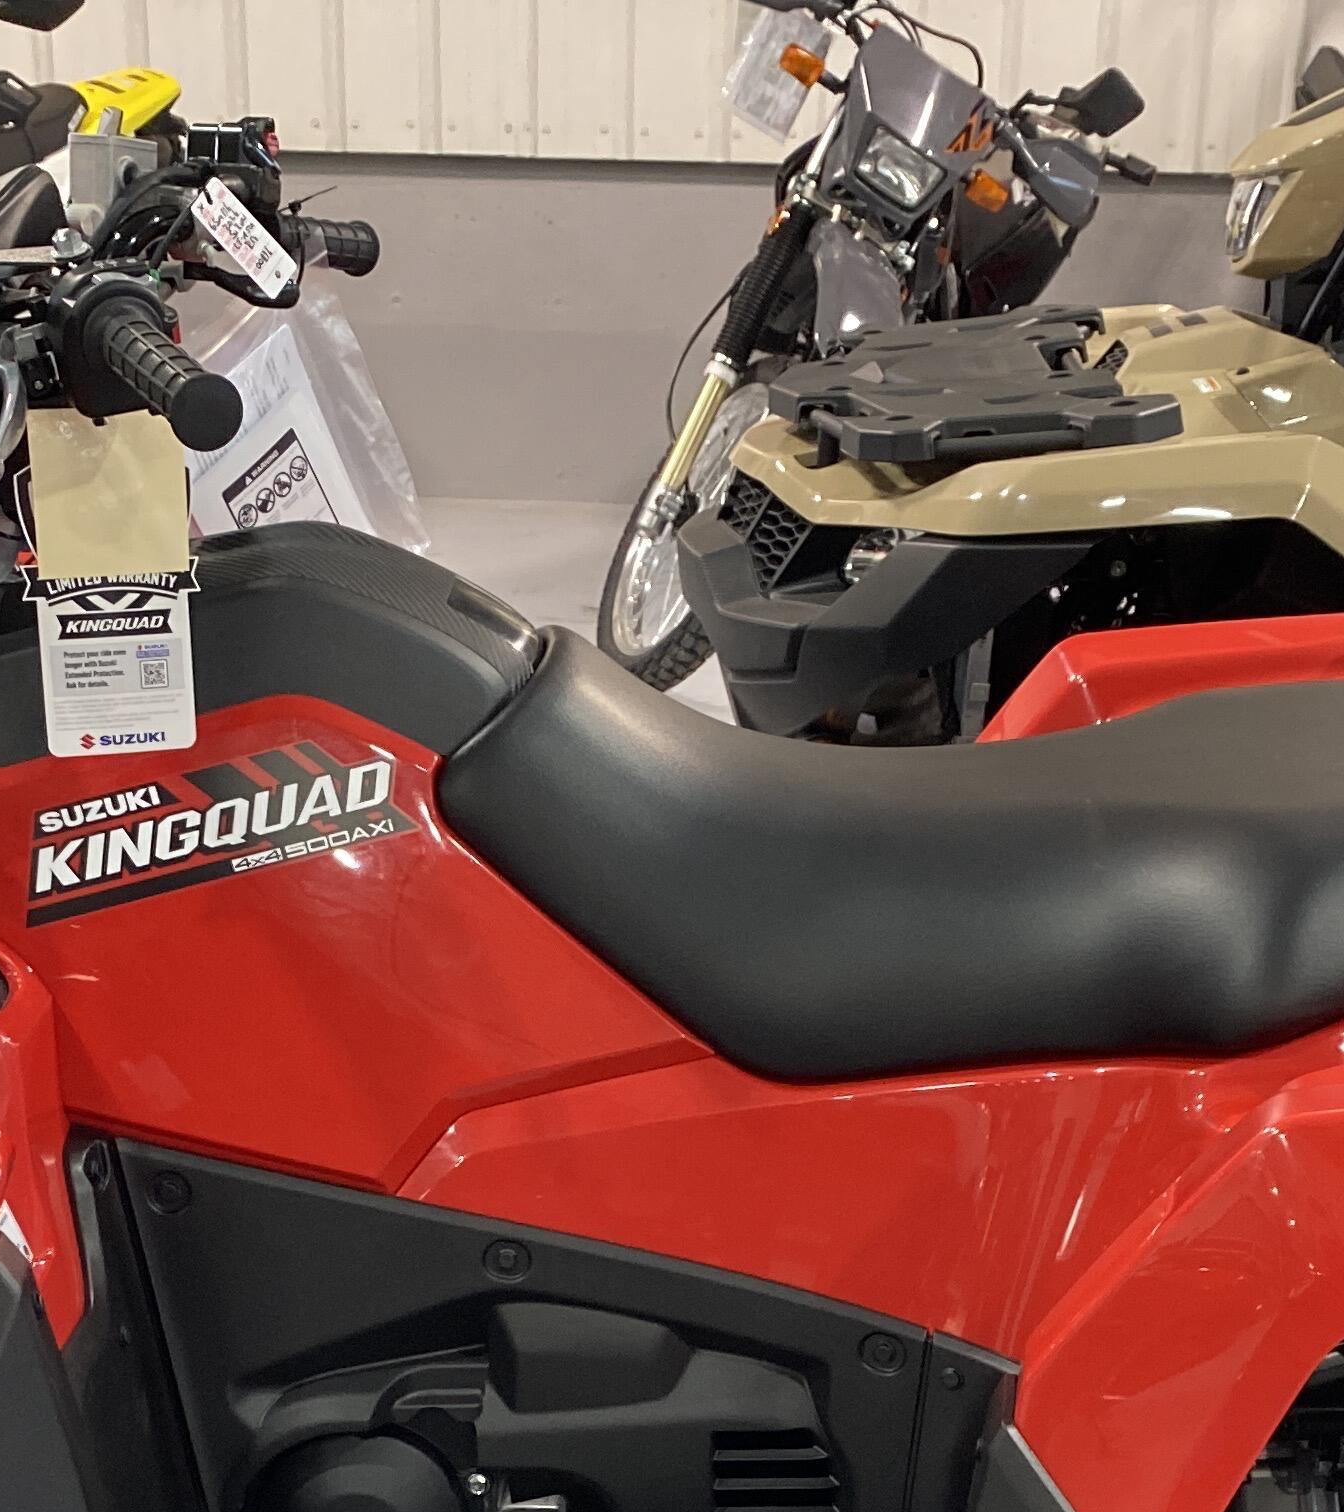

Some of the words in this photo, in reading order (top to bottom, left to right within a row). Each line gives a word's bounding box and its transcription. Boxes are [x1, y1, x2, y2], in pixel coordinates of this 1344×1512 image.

[65, 615, 165, 634] KINGQUAD
[99, 731, 166, 746] SUZUKI
[39, 785, 161, 833] SUZUKI
[35, 760, 391, 893] KINGQUAD
